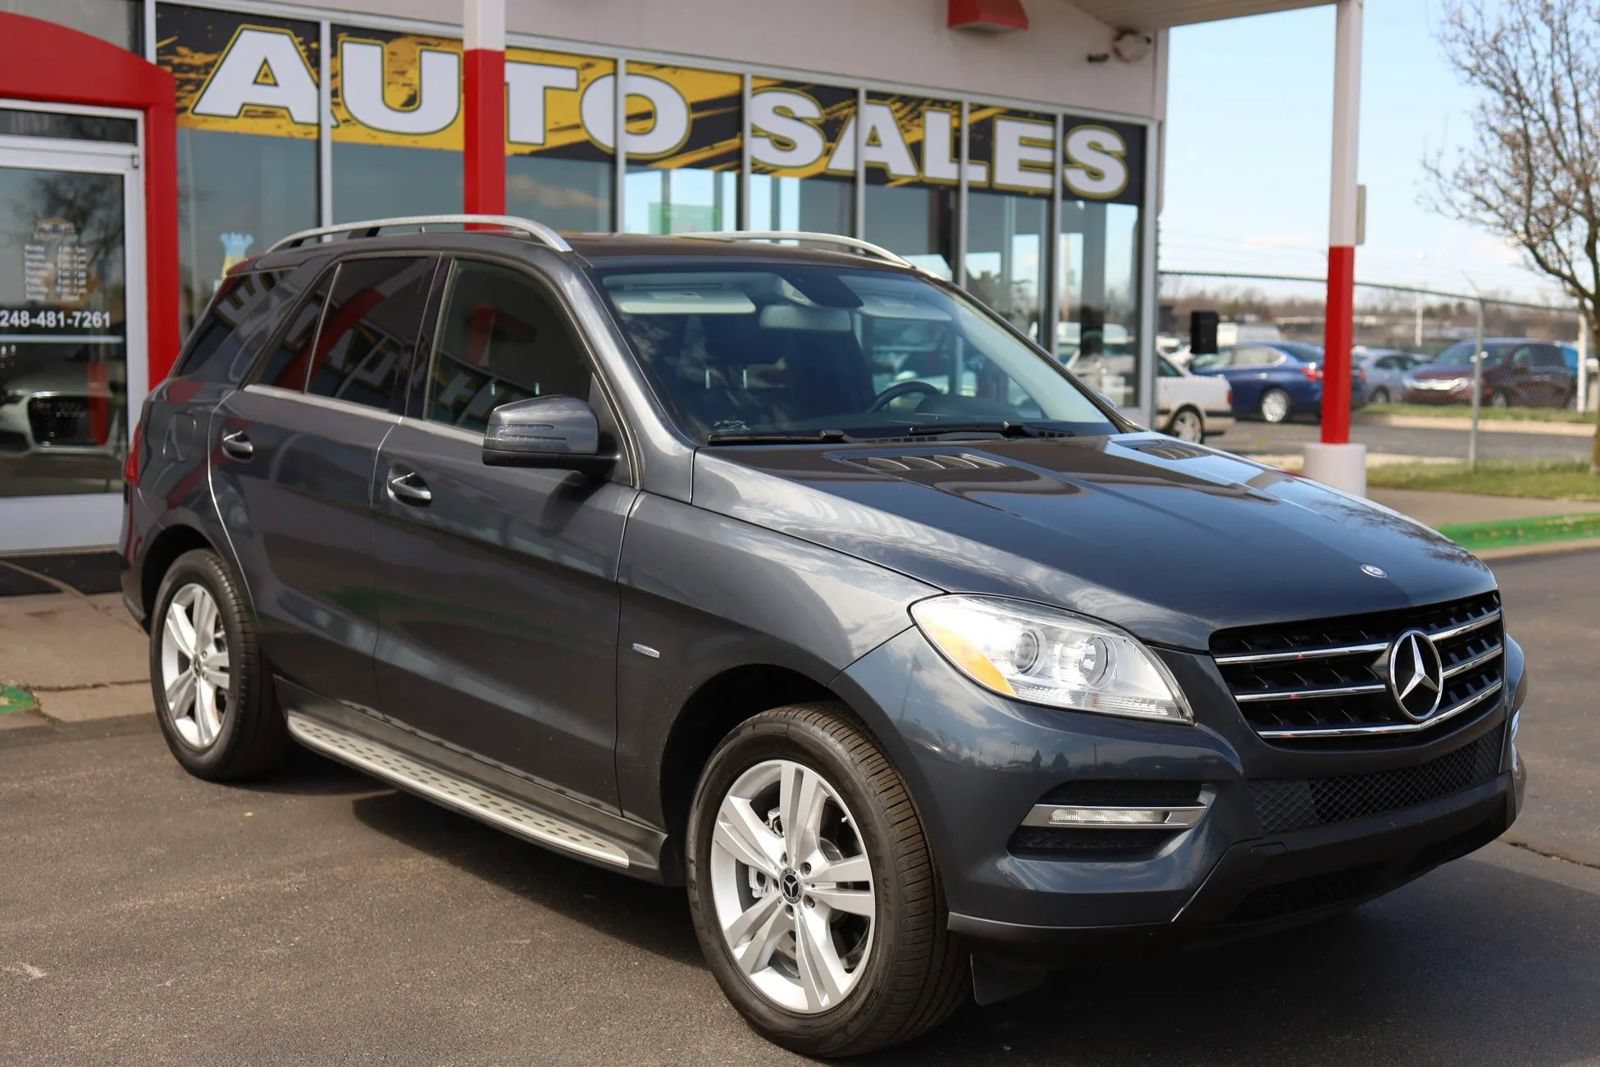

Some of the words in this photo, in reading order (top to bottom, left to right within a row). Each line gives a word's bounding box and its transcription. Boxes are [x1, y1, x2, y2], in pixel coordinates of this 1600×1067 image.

[192, 26, 691, 155] AUTO
[750, 90, 1128, 197] SALES
[0, 310, 110, 328] 248-481-7261
